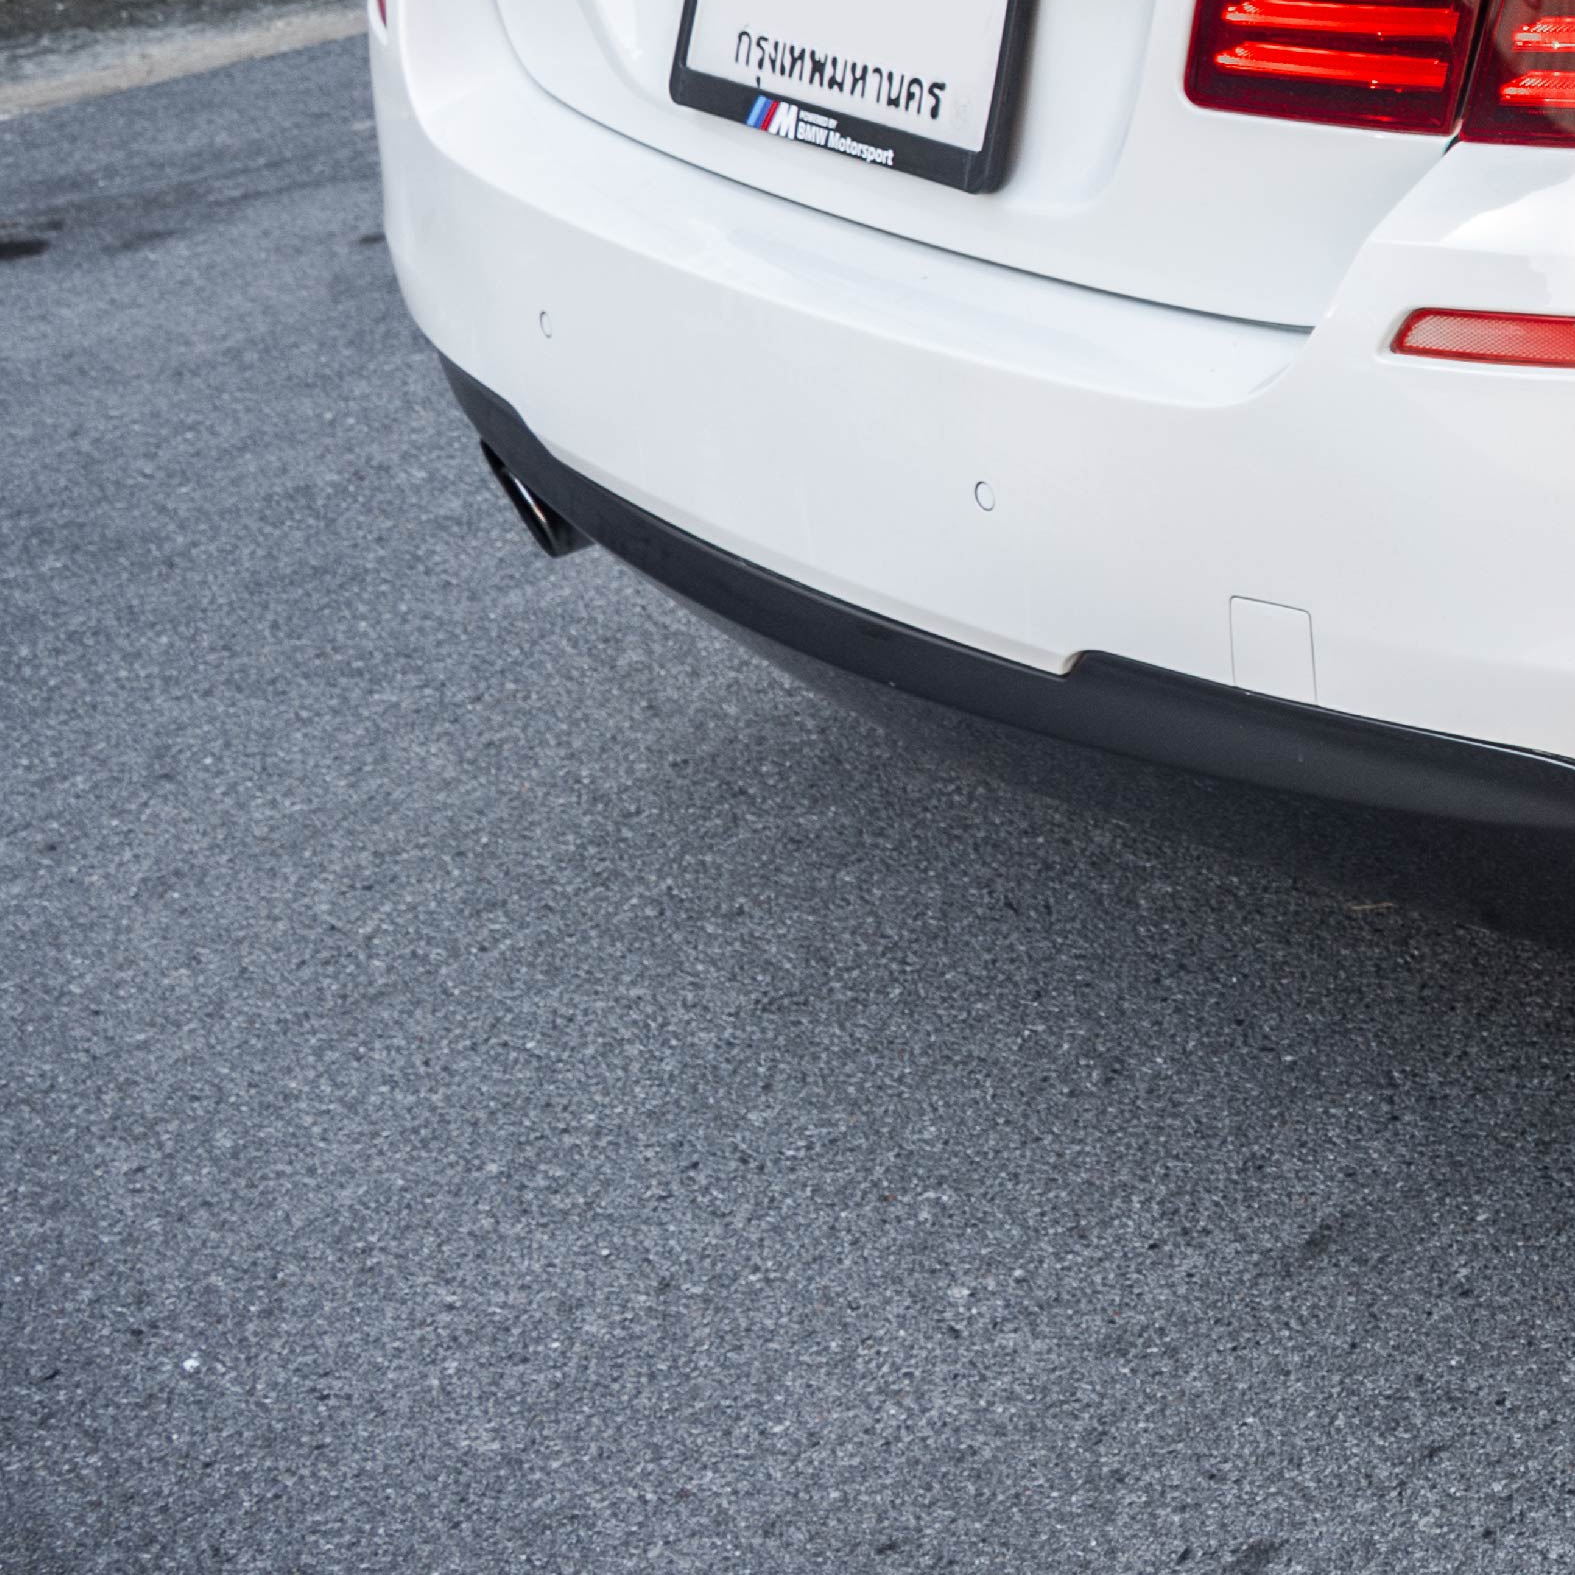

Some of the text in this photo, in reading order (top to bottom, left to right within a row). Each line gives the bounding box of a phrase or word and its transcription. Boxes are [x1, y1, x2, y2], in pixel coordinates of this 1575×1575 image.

[734, 29, 947, 120] กรุงเทพมหานคร
[797, 121, 895, 166] BMW Motorsport
